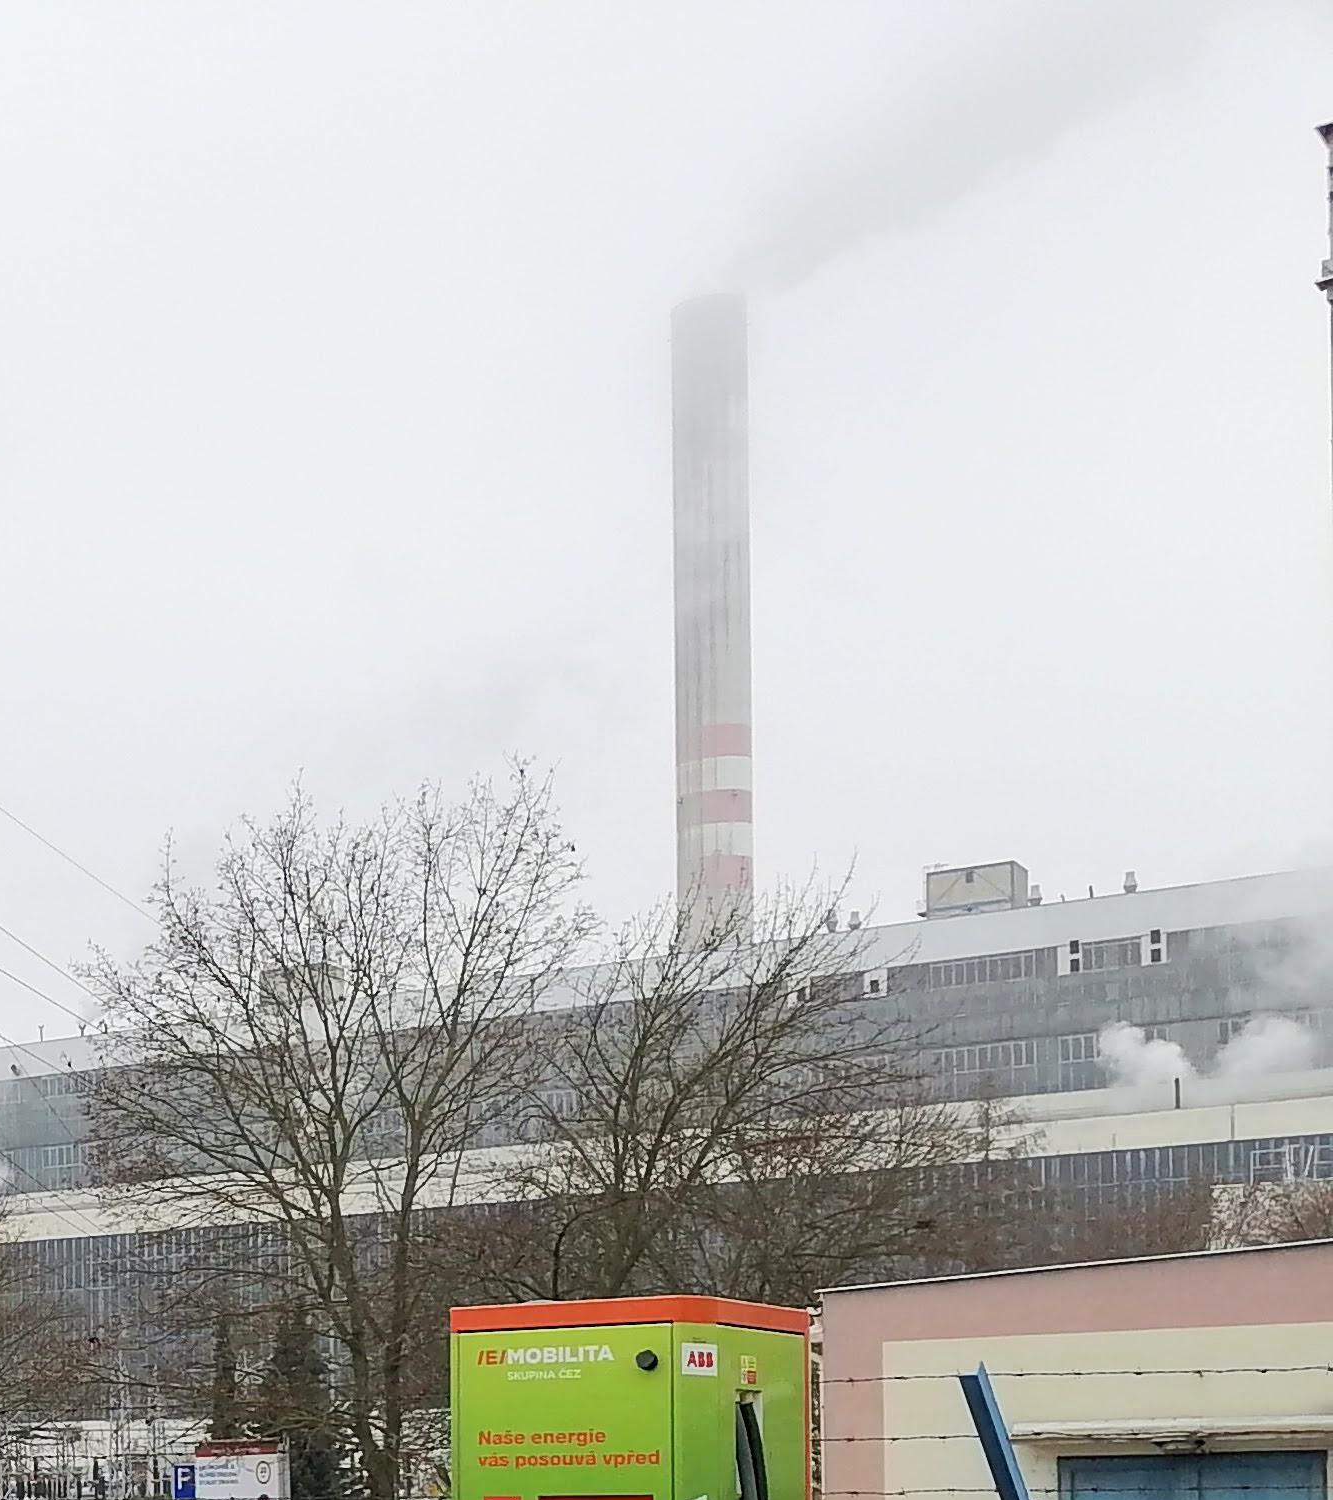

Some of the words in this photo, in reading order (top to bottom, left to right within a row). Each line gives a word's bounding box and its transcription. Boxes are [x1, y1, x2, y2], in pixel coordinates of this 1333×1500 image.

[687, 1350, 714, 1368] ABB
[507, 1370, 556, 1381] SKUPINA
[558, 1369, 581, 1379] ČEZ
[478, 1430, 525, 1446] Naše
[531, 1429, 606, 1446] energie
[478, 1453, 509, 1467] vás
[515, 1451, 597, 1469] posouvá
[603, 1450, 660, 1467] vpřed
[177, 1467, 191, 1490] P
